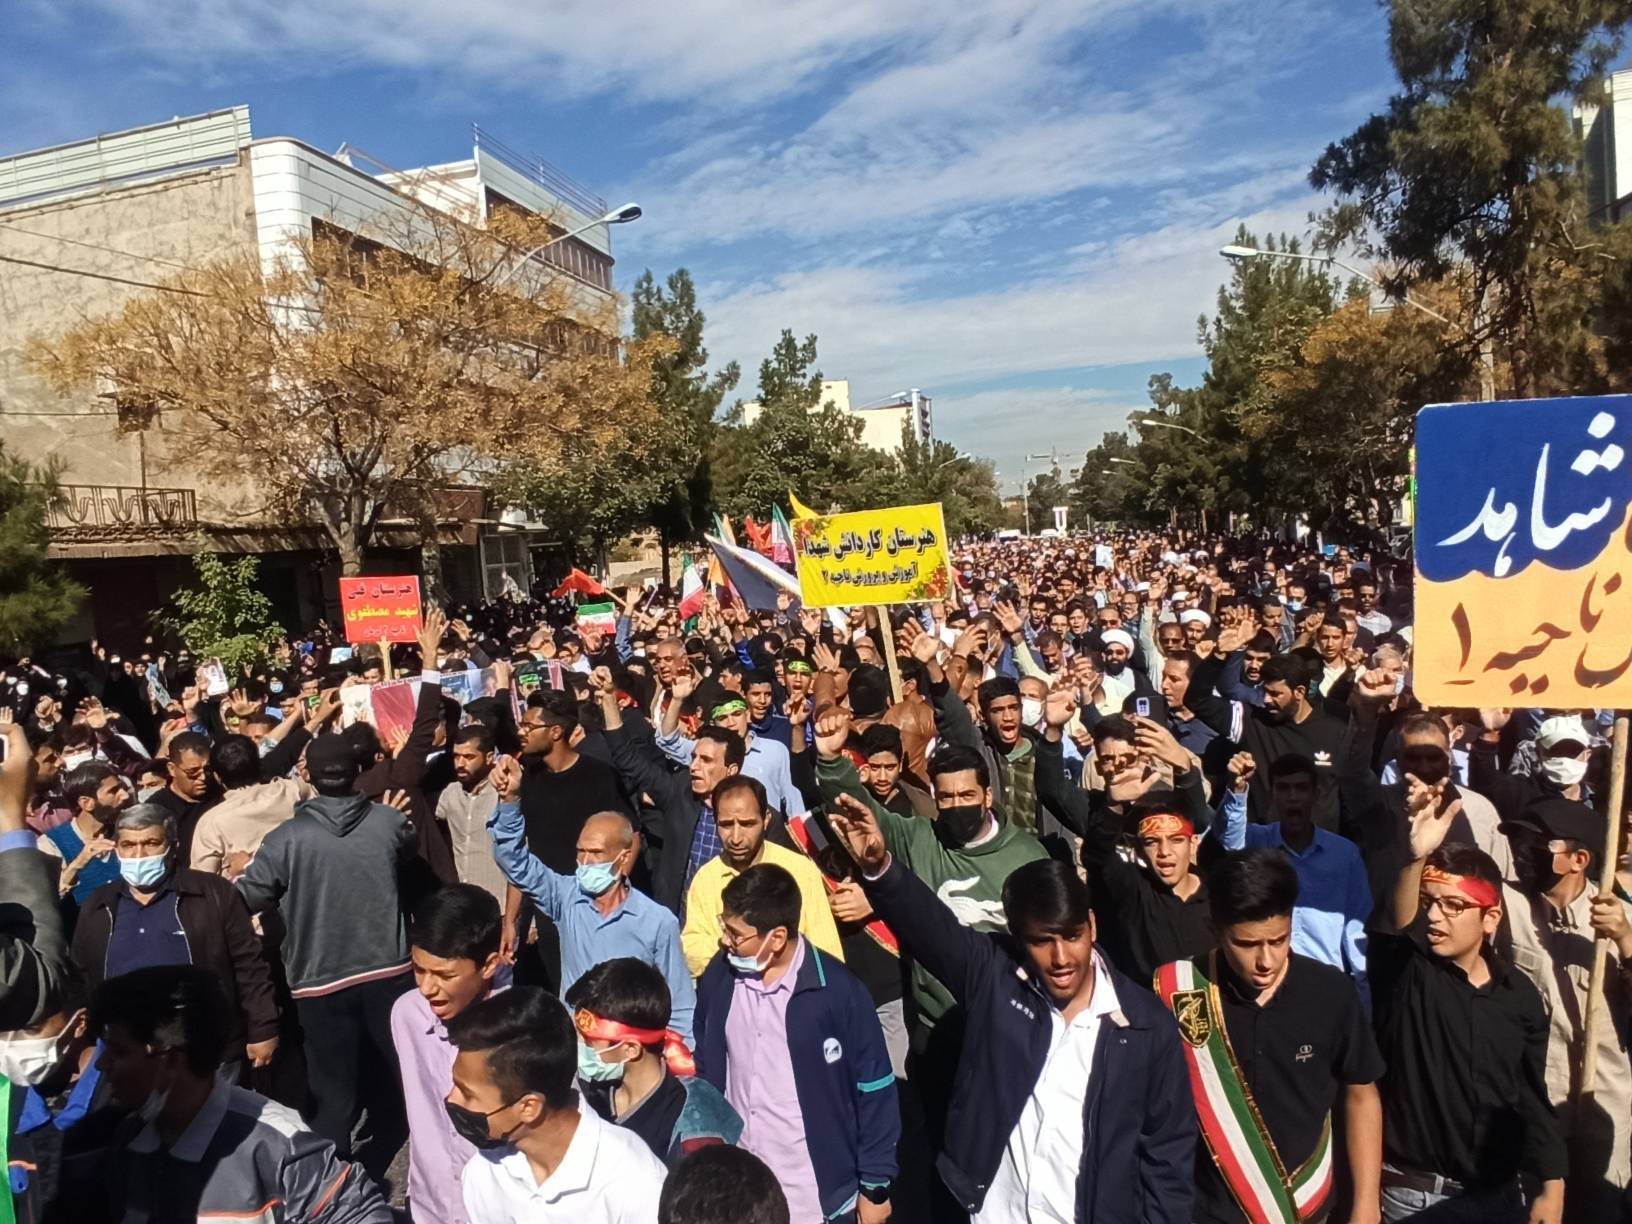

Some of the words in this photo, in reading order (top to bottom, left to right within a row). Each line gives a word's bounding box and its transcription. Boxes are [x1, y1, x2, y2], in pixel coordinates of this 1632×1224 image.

[1435, 411, 1625, 578] شاهد
[803, 533, 831, 558] شهدا
[886, 527, 938, 556] هنرستان
[830, 568, 851, 585] ناحیه
[853, 568, 879, 586] پرورش
[888, 561, 918, 584] آموزش
[371, 583, 412, 599] هنرستان
[394, 604, 419, 619] شهید
